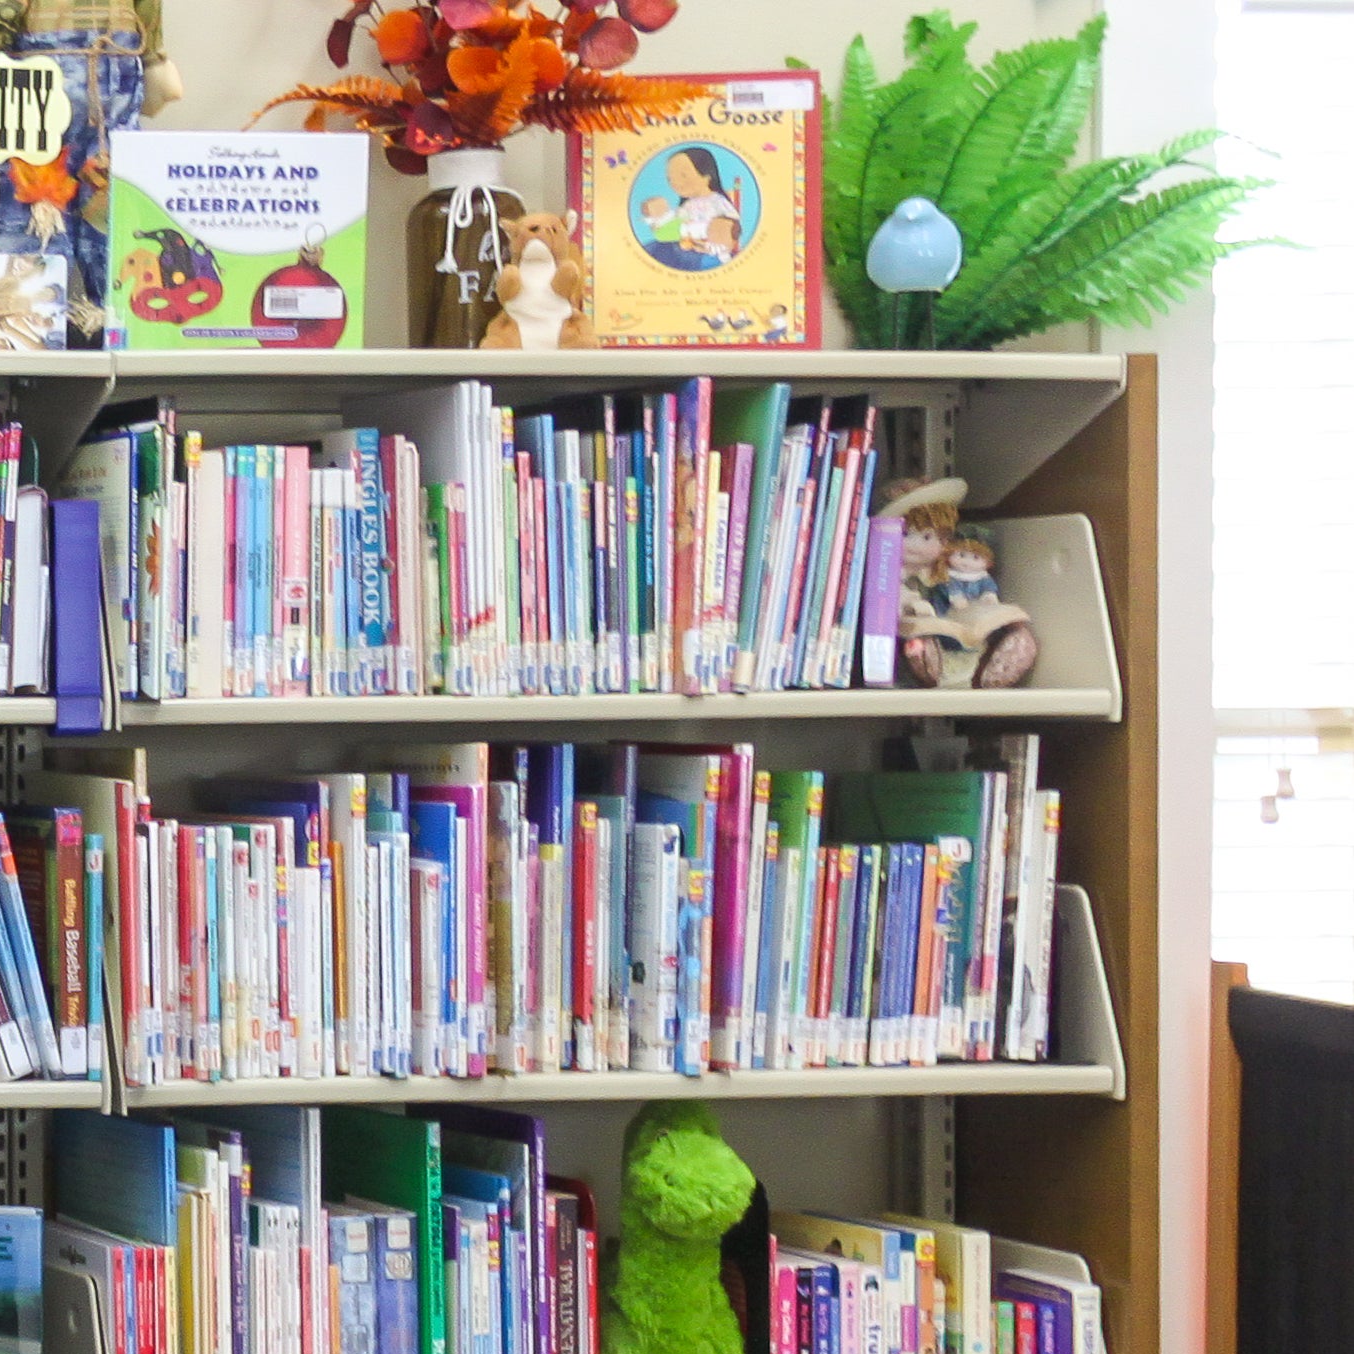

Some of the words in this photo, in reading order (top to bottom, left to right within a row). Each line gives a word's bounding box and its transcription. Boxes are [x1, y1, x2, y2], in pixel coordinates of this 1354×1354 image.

[273, 166, 319, 181] AND
[164, 197, 321, 214] CELEBRATIONS
[363, 553, 381, 625] BOOK
[66, 930, 81, 992] Baseball
